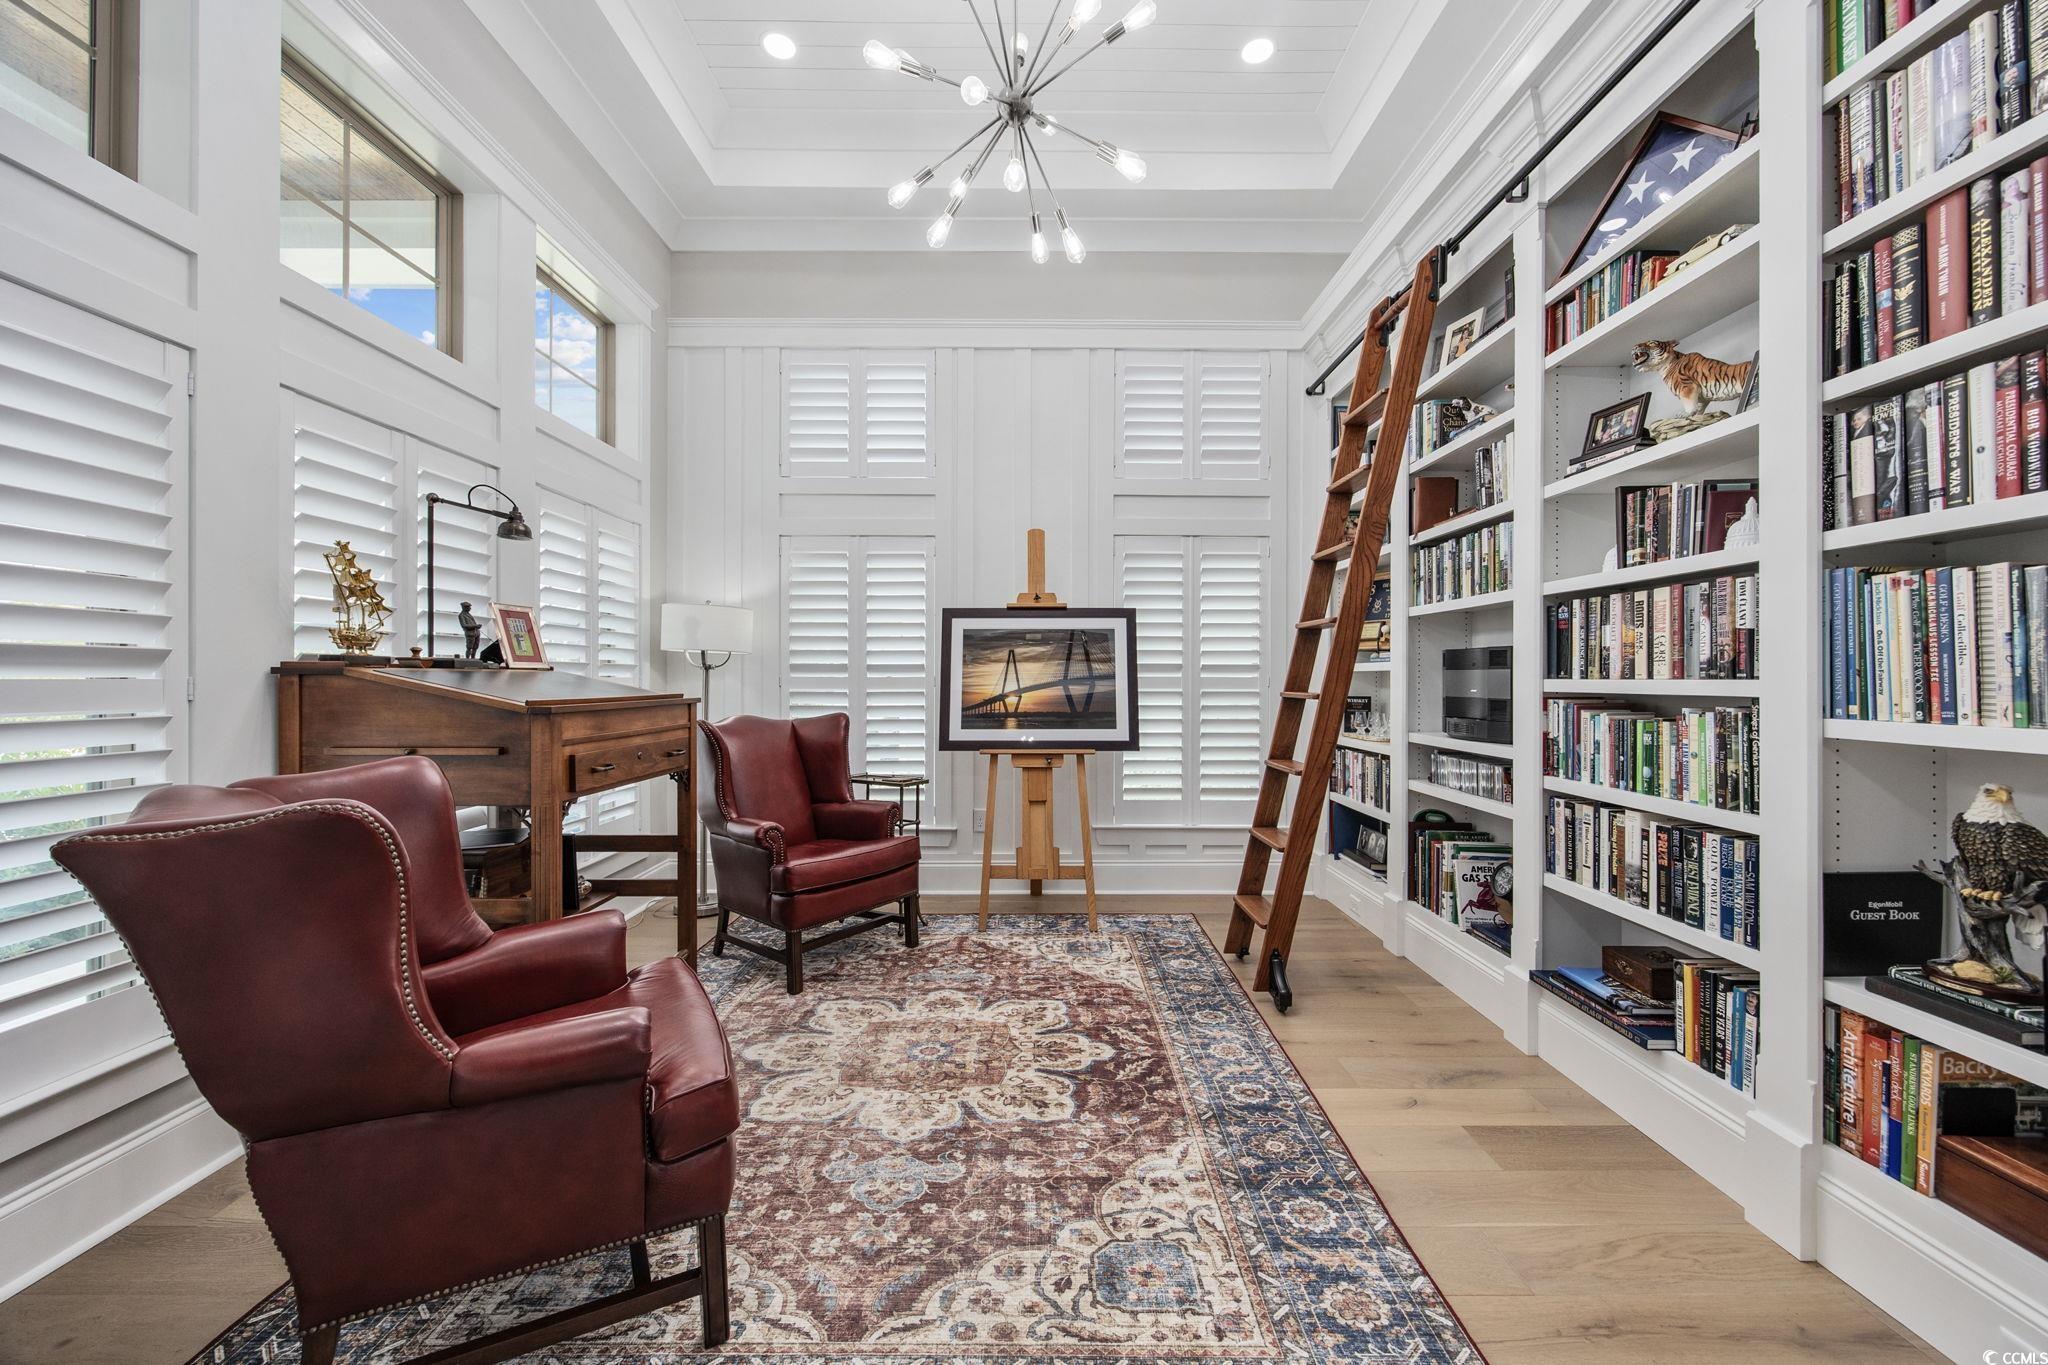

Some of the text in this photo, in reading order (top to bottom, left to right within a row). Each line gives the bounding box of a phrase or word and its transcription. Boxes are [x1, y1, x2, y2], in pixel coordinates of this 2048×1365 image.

[1842, 11, 1856, 41] TOUR
[1882, 258, 1890, 280] SOUL
[1938, 244, 1948, 296] MARK TWAIN
[1971, 220, 1982, 311] HAMILTON
[1980, 218, 1992, 309] ALEXANDER
[2006, 214, 2026, 300] Benjamin Franklin
[2026, 358, 2039, 390] FEAR
[1948, 390, 1960, 495] PRESIDENTS WAR
[2006, 390, 2018, 480] PRESIDENTIAL COURAGE
[2027, 408, 2041, 490] BOB WOODWARD
[1718, 580, 1727, 592] DAN
[1927, 582, 1936, 600] JACK
[1939, 584, 1949, 606] GOLF
[1635, 600, 1644, 628] ROOTS
[1654, 600, 1666, 633] LINCOLN
[1718, 594, 1727, 616] BROWN
[1738, 580, 1748, 628] TOM CLANCY
[1911, 596, 1919, 609] Play
[1956, 592, 1965, 611] Golf
[1928, 602, 1937, 637] NICKLAUS
[1940, 613, 1950, 643] DESIGN
[1658, 634, 1666, 666] GORE
[1876, 630, 1882, 640] On
[1956, 614, 1967, 666] Collectibles
[1929, 638, 1938, 666] LESSON
[1913, 642, 1923, 703] TIGER WOODS
[1751, 705, 1759, 730] Strokes
[1750, 732, 1760, 740] of
[1610, 818, 1618, 842] Meeting
[1658, 833, 1668, 866] PRIZE
[1462, 874, 1480, 882] GAS
[1674, 862, 1682, 885] PRIVATE
[1688, 861, 1700, 918] BEST EVIDENCE
[1734, 860, 1742, 929] BREAKING COVER
[1744, 871, 1756, 925] SAM WALTON
[1868, 901, 1902, 909] ExxonMobil
[1895, 974, 1922, 987] Richmond
[1924, 981, 1934, 990] Hill
[1534, 976, 1552, 990] NATIONAL
[1552, 986, 1580, 1006] GEOGRAPHIC
[1580, 1002, 1596, 1016] ATLAS
[1604, 1018, 1614, 1027] THE
[1614, 1024, 1633, 1038] WORLD
[1716, 992, 1726, 1016] YANKEE
[1716, 1017, 1725, 1040] YEARS
[1744, 1047, 1752, 1083] HERNANDEZ
[1842, 1029, 1858, 1123] Architecture
[1871, 1058, 1882, 1069] 25
[1890, 1056, 1901, 1076] patio
[1920, 1050, 1933, 1106] BACKYARDS
[1890, 1081, 1902, 1101] deck
[1908, 1052, 1916, 1135] ST ANDREWS GOLF LINKS
[1918, 1160, 1928, 1188] Sunset
